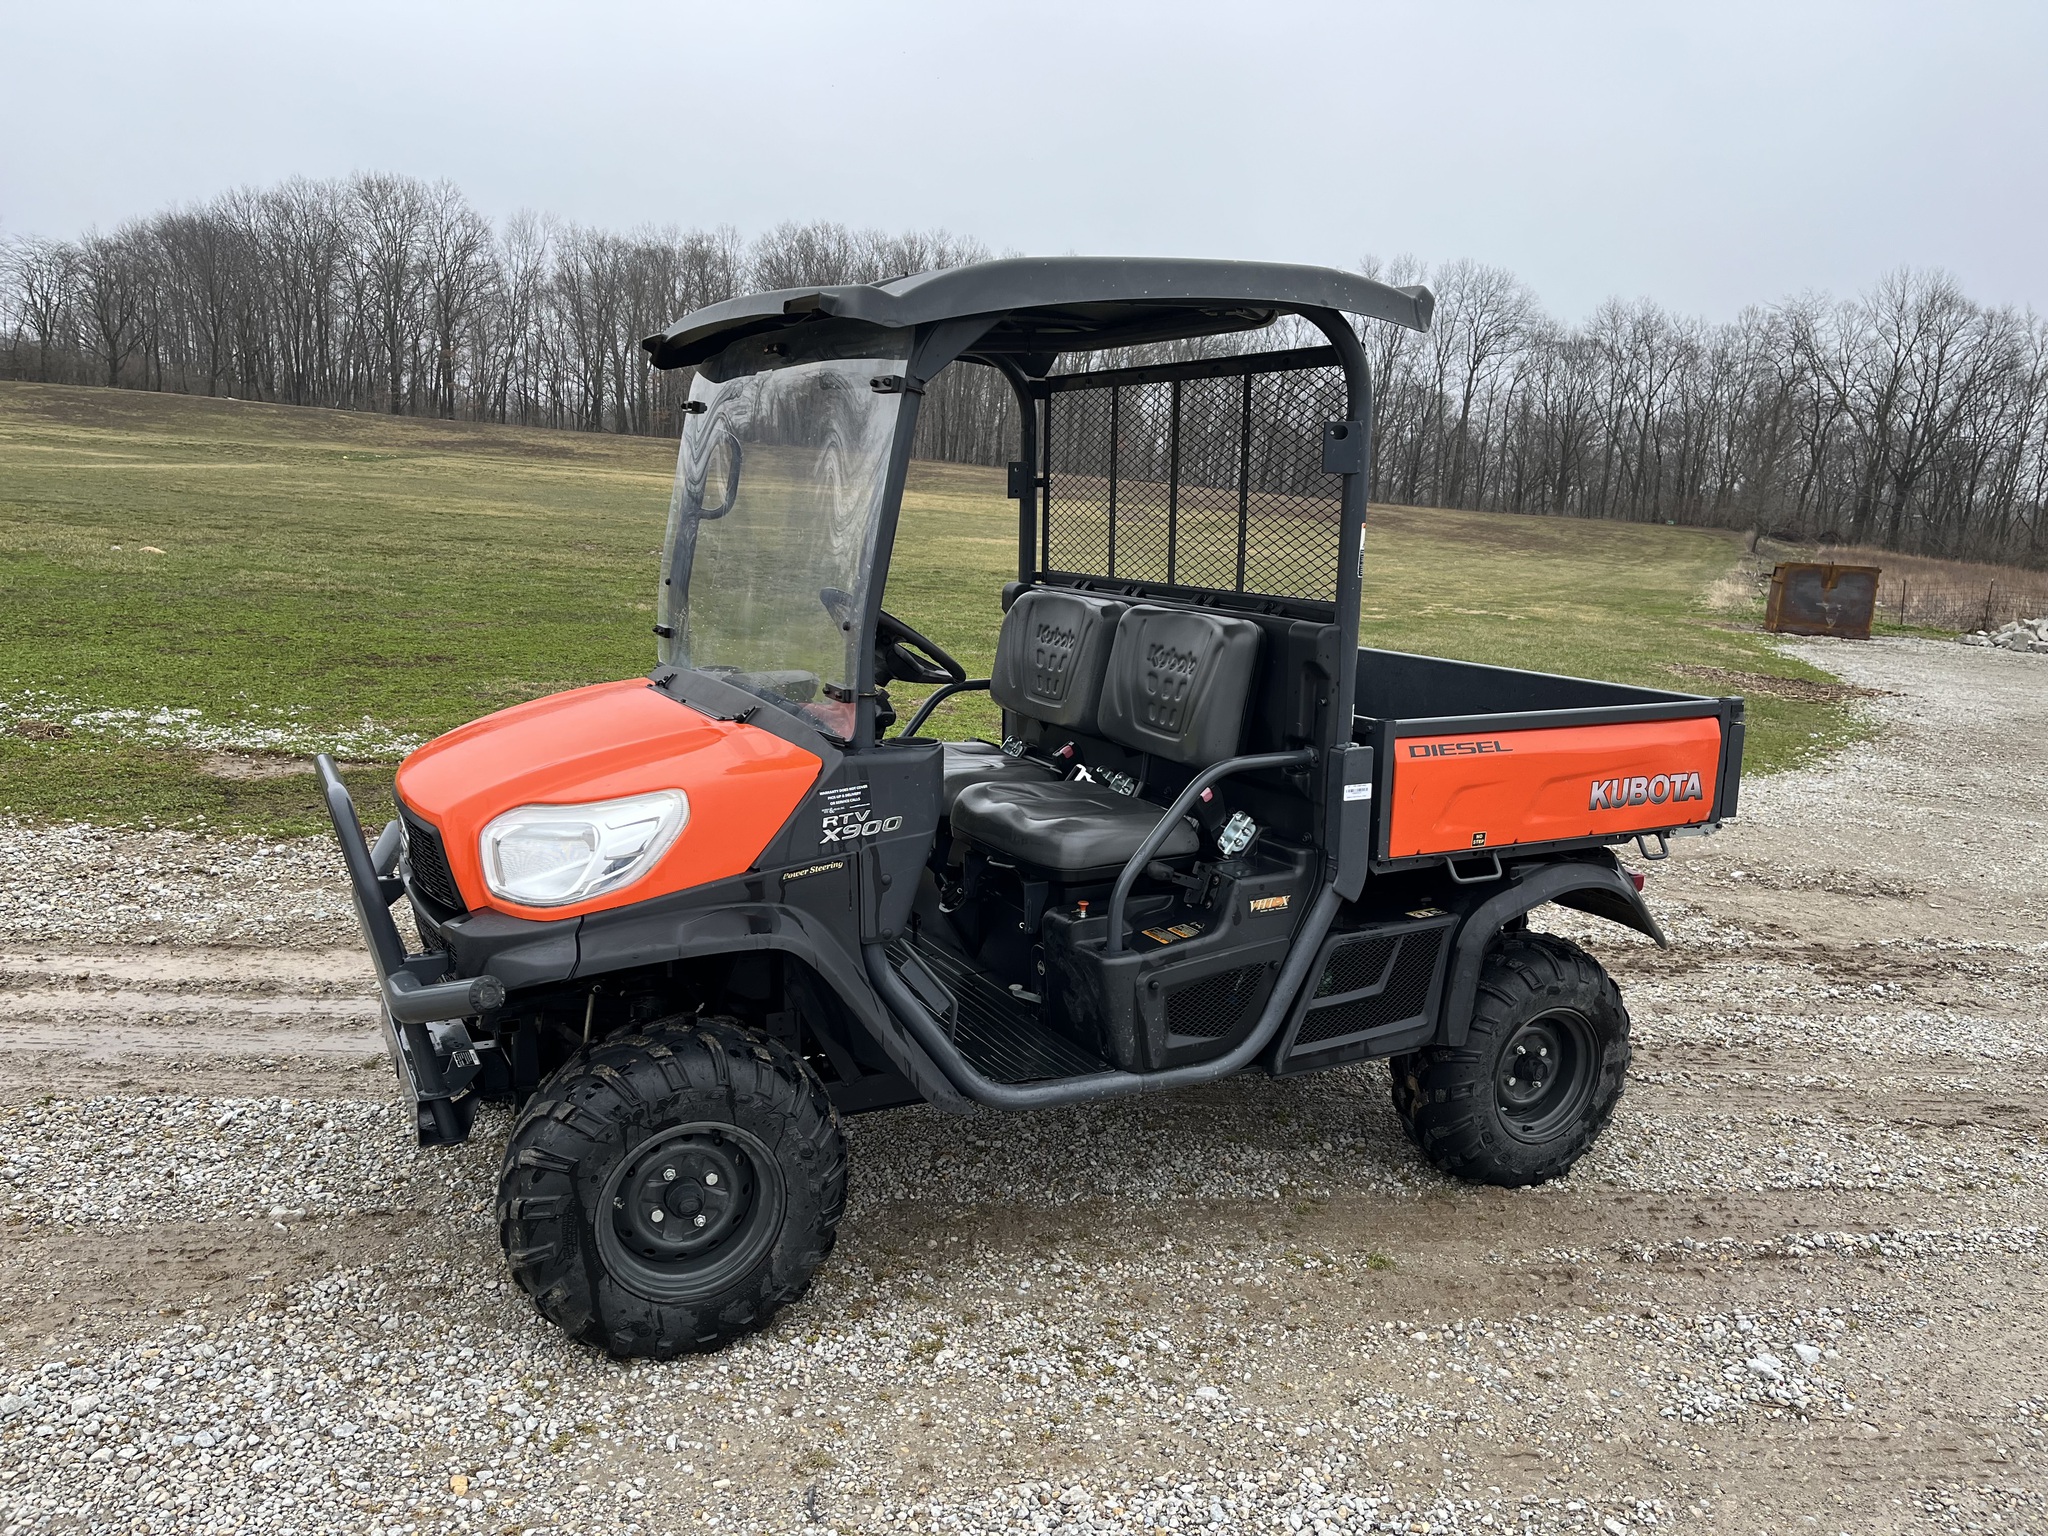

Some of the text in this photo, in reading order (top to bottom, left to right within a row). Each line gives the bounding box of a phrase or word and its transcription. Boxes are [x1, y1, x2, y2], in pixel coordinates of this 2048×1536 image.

[1408, 740, 1513, 758] DIESEL
[1588, 771, 1703, 811] KUBOTA
[822, 810, 871, 828] RTV
[819, 816, 903, 844] X900
[783, 861, 844, 880] Power Steering
